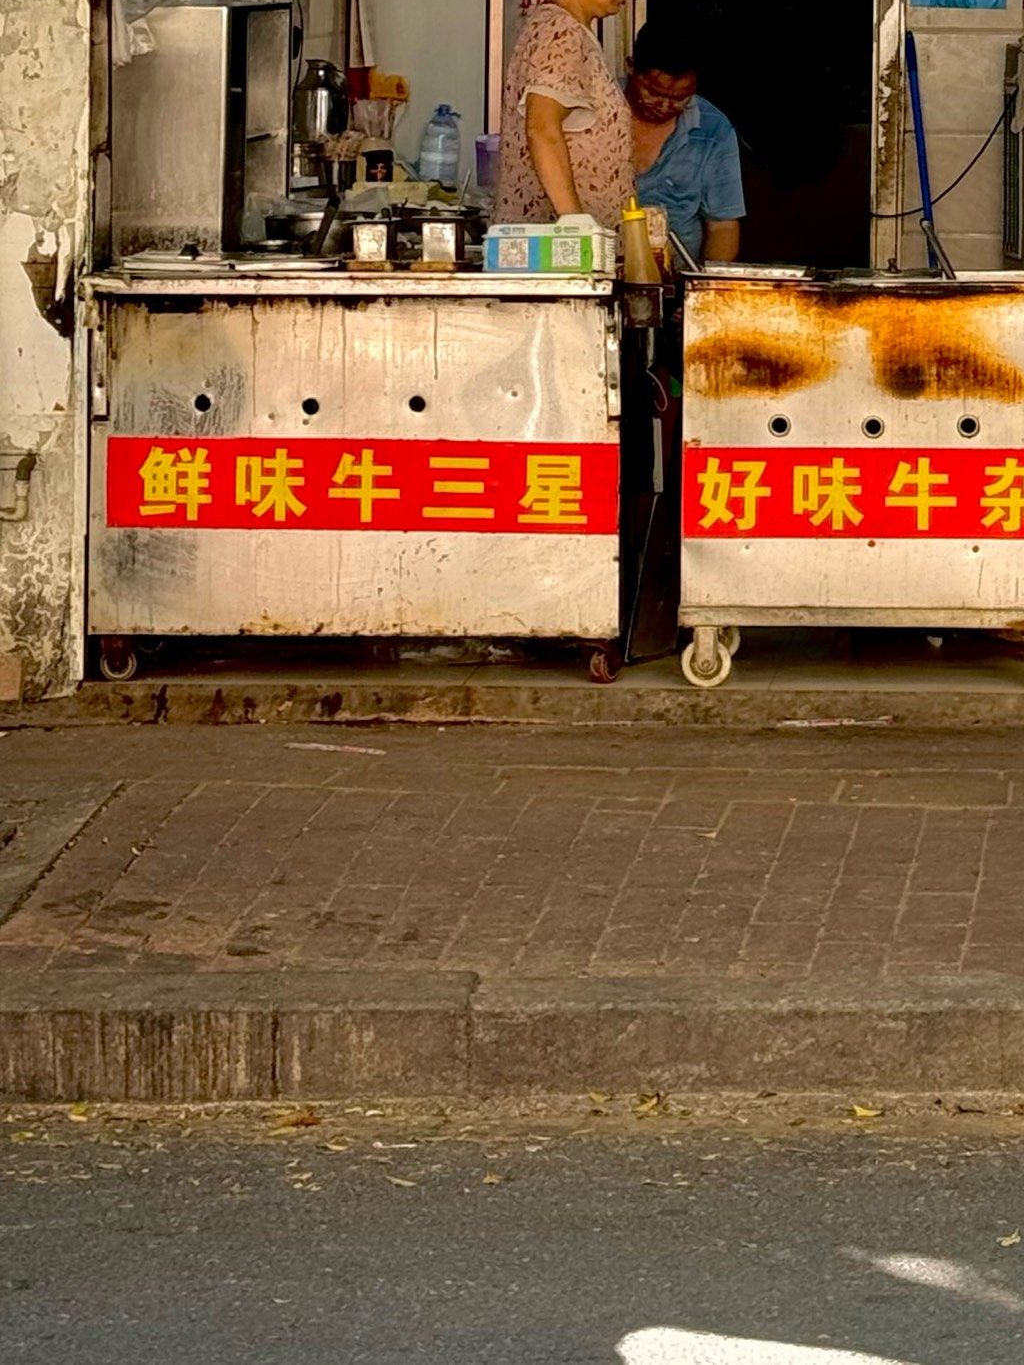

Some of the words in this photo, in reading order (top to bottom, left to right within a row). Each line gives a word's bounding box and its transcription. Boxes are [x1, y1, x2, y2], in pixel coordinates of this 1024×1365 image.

[138, 445, 589, 526] 鲜味牛三星
